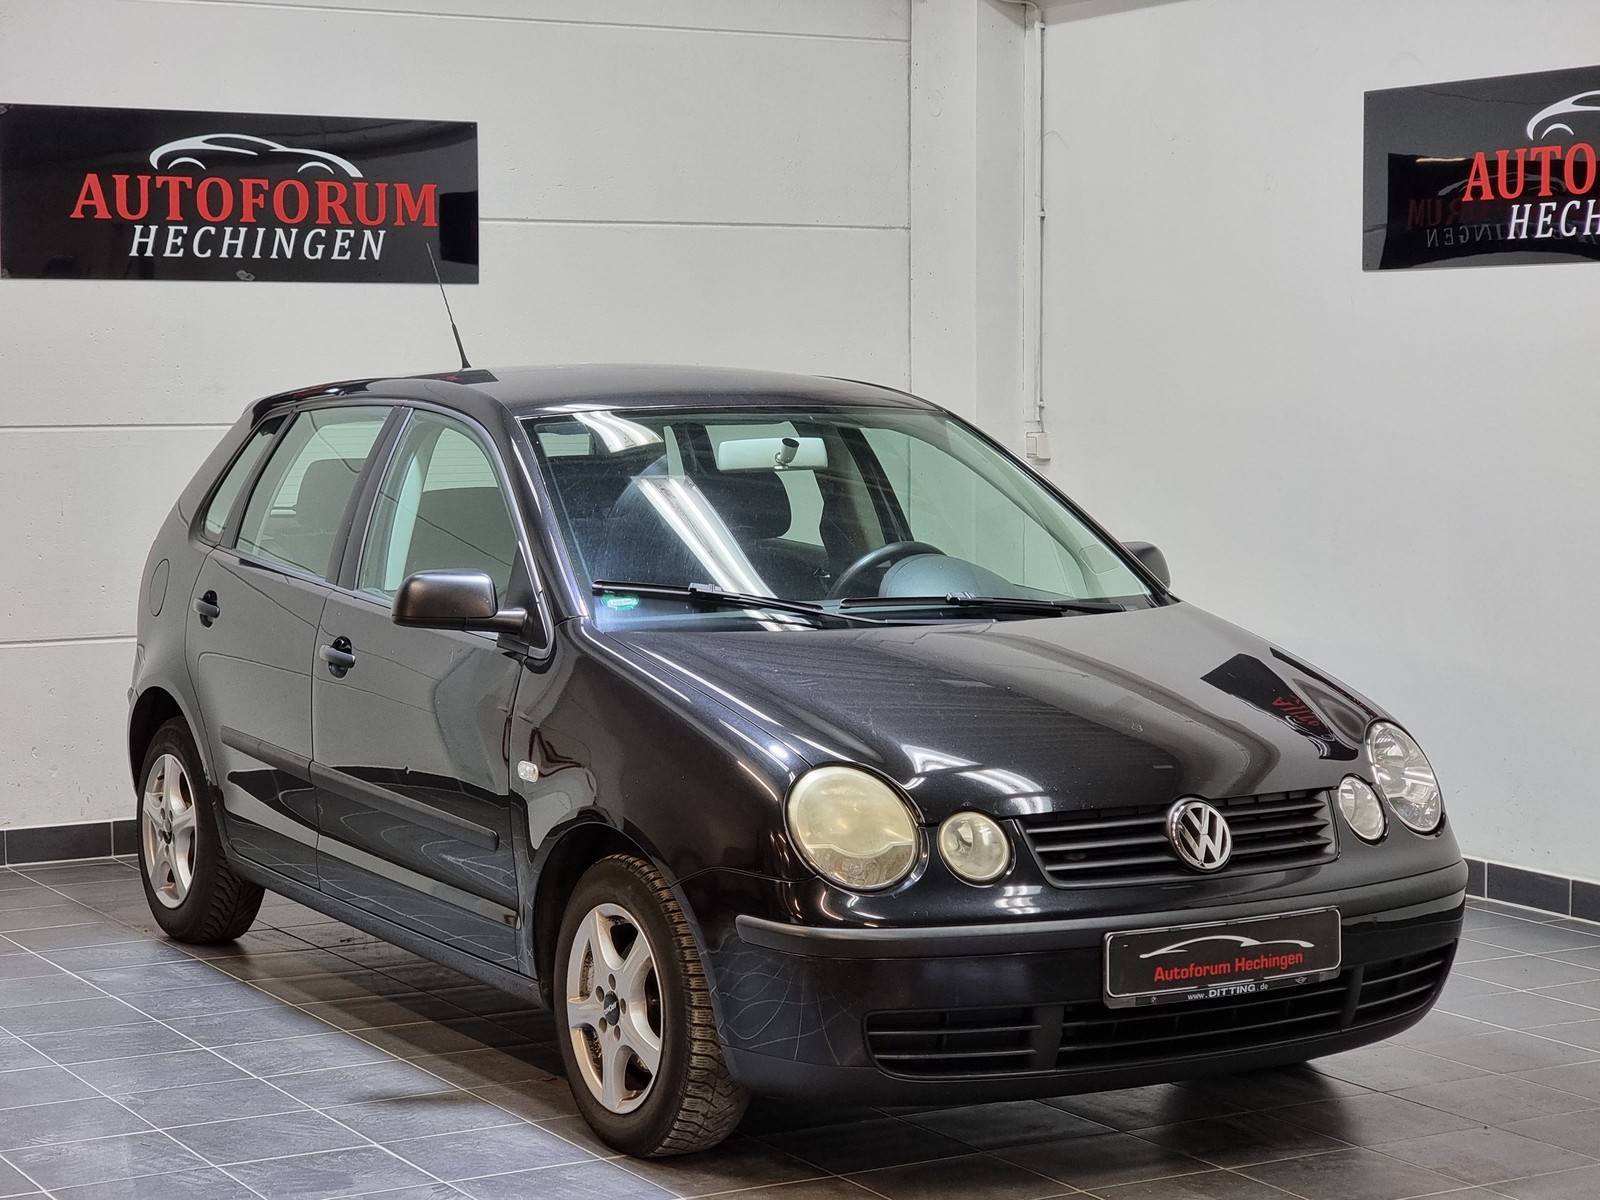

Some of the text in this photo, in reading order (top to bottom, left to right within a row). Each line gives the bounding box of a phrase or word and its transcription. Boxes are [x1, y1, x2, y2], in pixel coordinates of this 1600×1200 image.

[1462, 142, 1597, 202] AUTO
[70, 173, 437, 227] AUTOFORUM
[129, 225, 387, 261] HECHINGEN
[1153, 953, 1304, 982] Autoforum Hechingen
